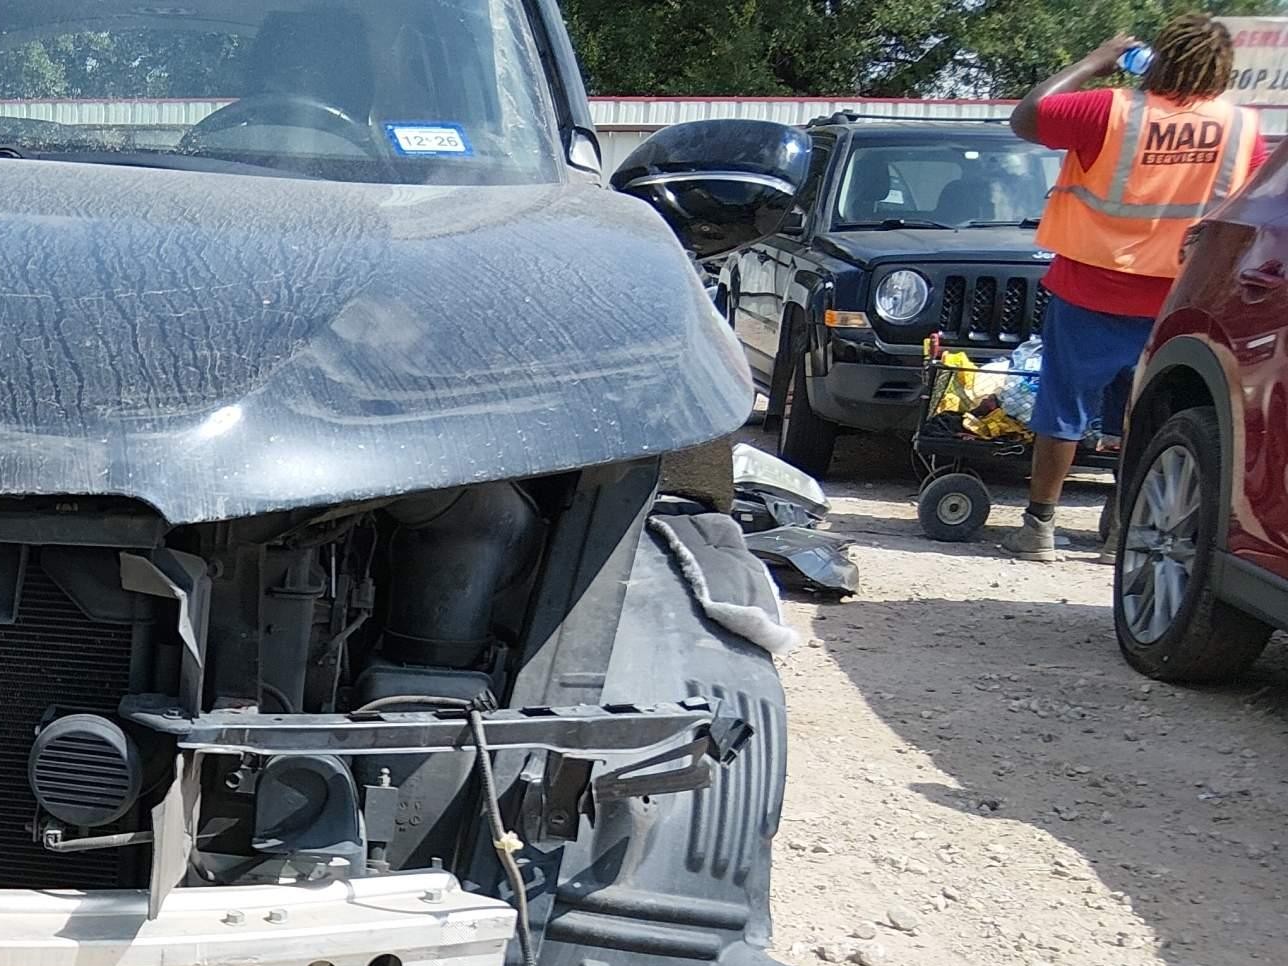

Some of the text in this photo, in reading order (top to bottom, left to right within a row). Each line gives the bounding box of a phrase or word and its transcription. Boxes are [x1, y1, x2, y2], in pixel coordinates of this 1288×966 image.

[1227, 69, 1268, 90] ROP
[1144, 121, 1223, 151] MAD
[1145, 152, 1215, 164] SERVICES
